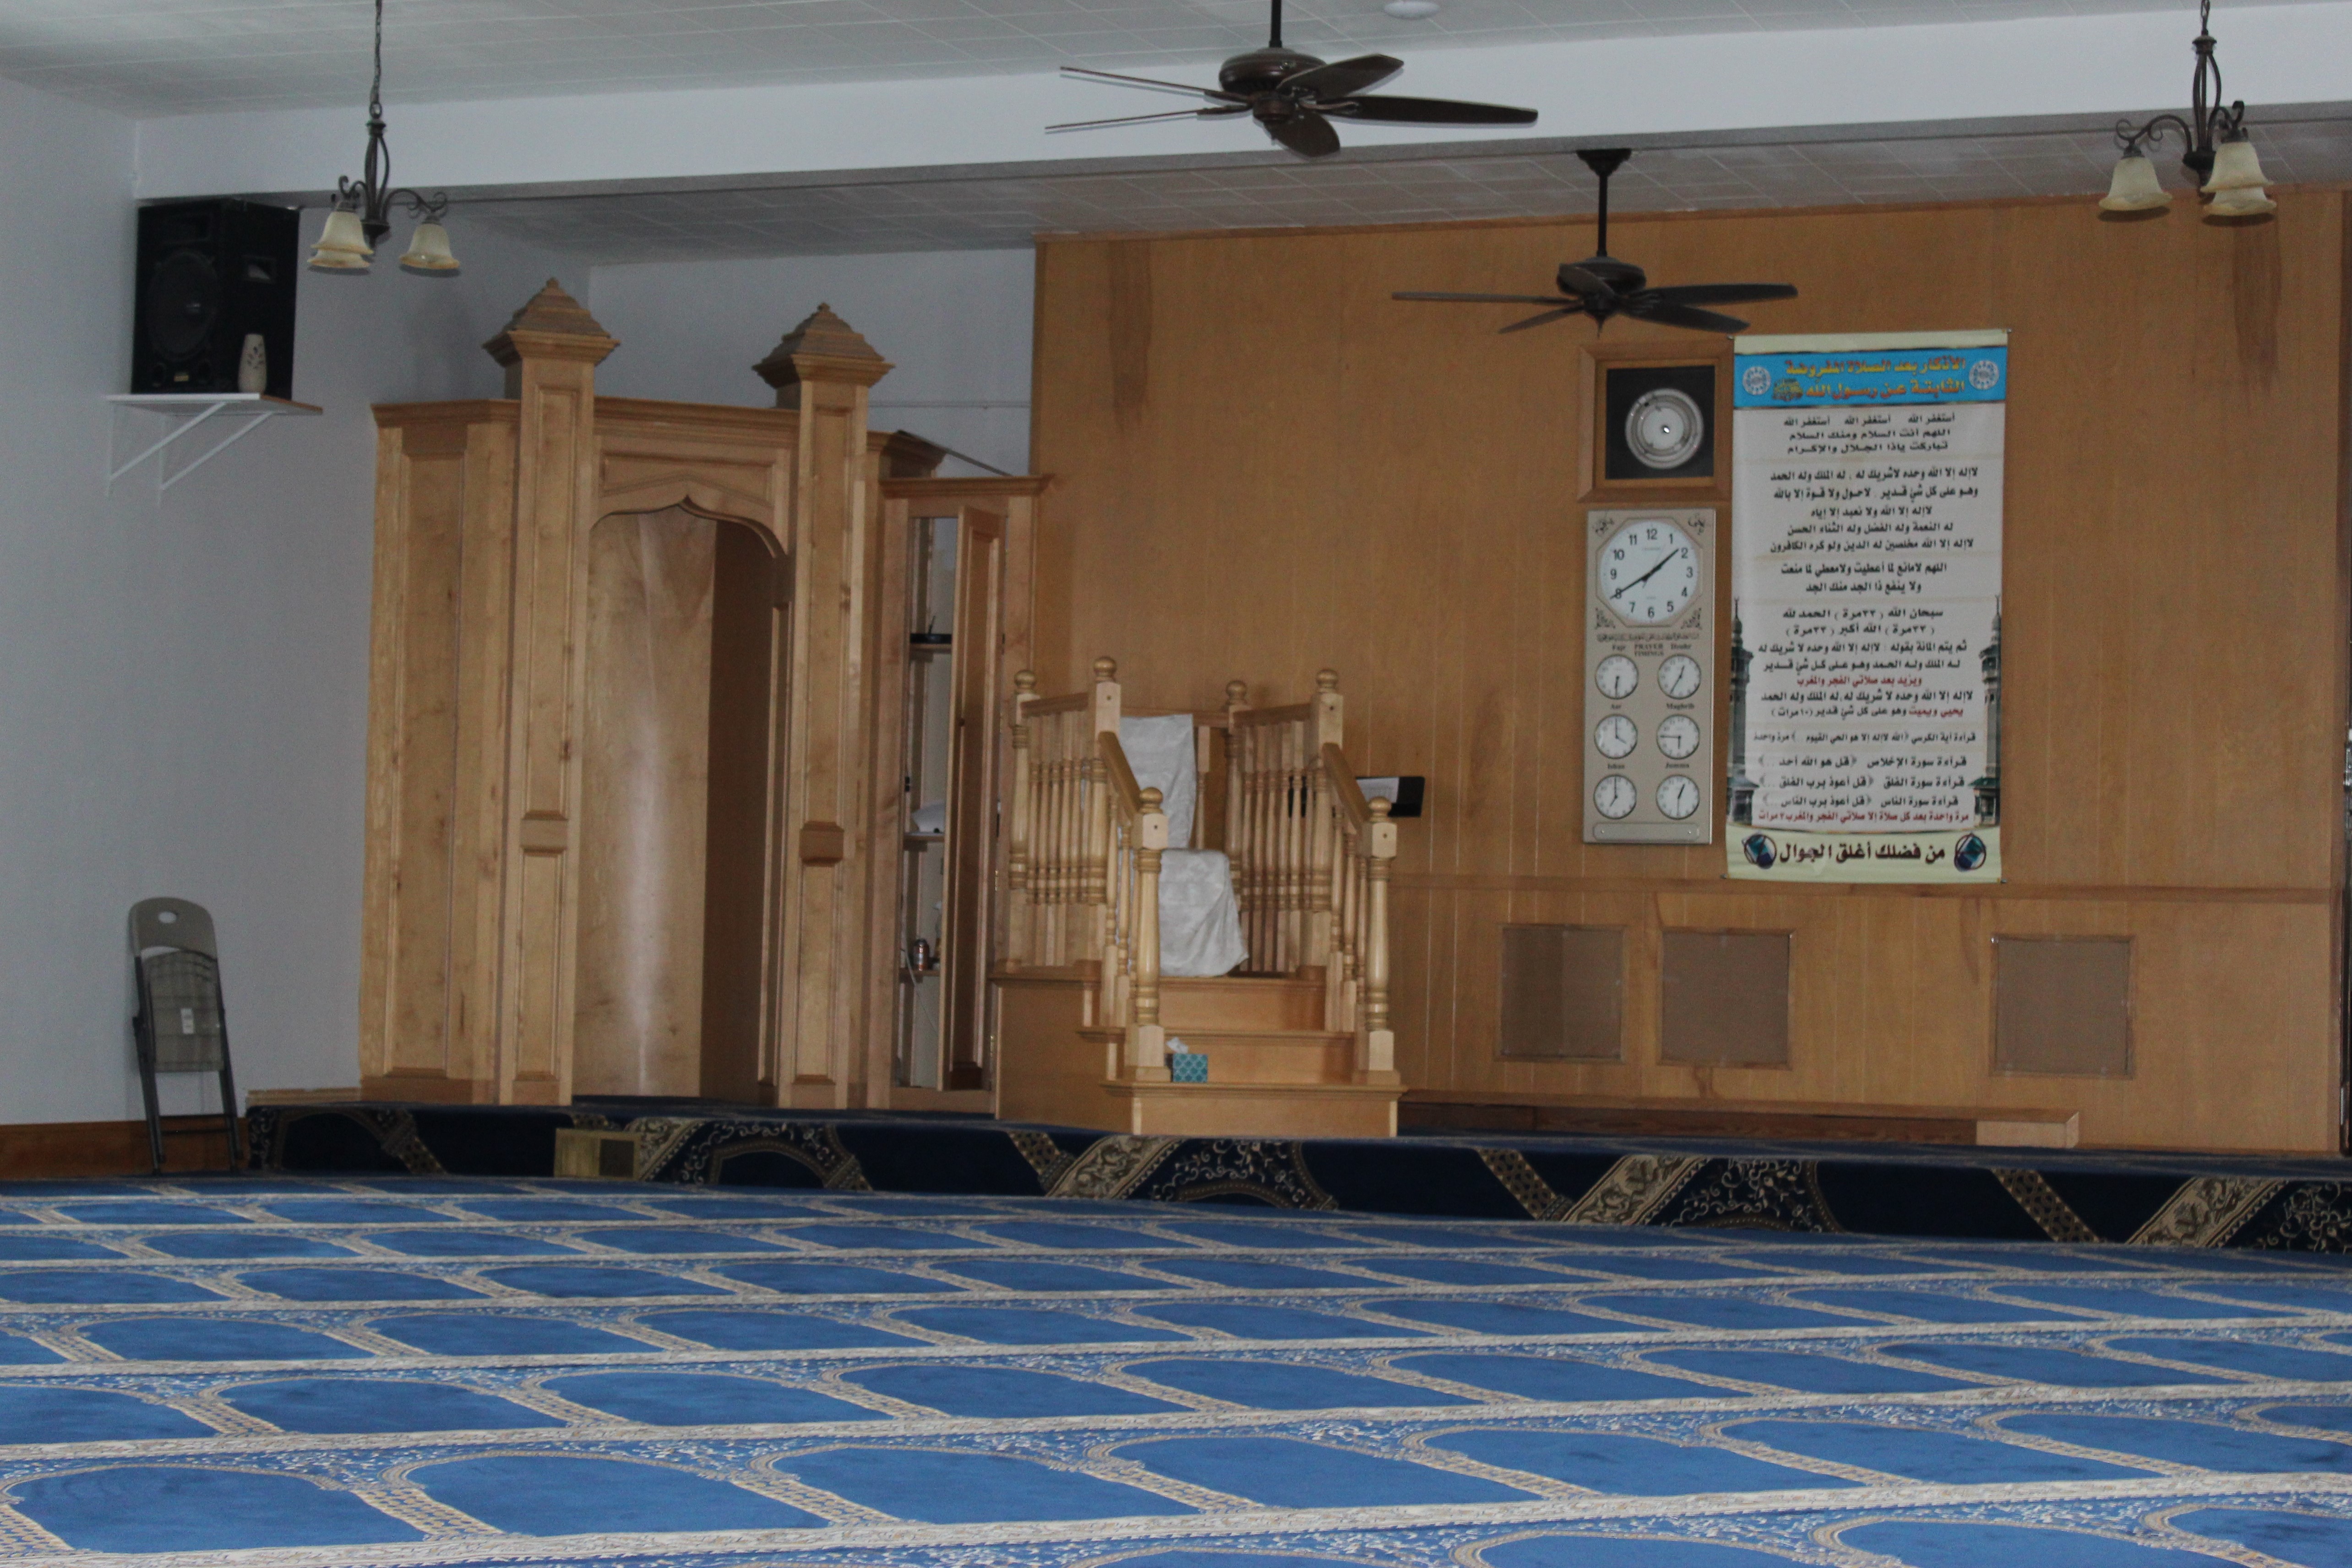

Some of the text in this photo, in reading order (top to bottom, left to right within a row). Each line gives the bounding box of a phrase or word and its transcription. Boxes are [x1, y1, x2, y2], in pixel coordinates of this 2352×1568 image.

[1846, 359, 1891, 374] الصلاة
[1895, 361, 1917, 375] بعد
[1806, 384, 1831, 397] الله
[1833, 383, 1877, 399] رسول
[1880, 382, 1906, 398] عن
[1911, 377, 1965, 398] الثابتة
[1784, 412, 1955, 427] أستغفر الله أستغفر الله أستغفر الله
[1789, 432, 1824, 441] السلام
[1828, 430, 1857, 440] ومنك
[1861, 430, 1895, 439] السلام
[1923, 428, 1950, 438] اللهم
[1841, 443, 1882, 453] الجلال
[1910, 440, 1948, 451] تباركت
[1770, 471, 1795, 480] الحمد
[1799, 471, 1812, 483] وله
[1814, 469, 1834, 479] الملك
[1837, 469, 1845, 479] له
[1856, 469, 1865, 479] له
[1903, 470, 1925, 480] وحده
[1928, 466, 1942, 477] الله
[1945, 467, 1955, 480] إلا
[1774, 487, 1791, 501] بالله
[1794, 489, 1803, 501] إلا
[1807, 486, 1824, 501] قوة
[1829, 488, 1840, 500] ولا
[1880, 485, 1907, 500] قدير
[1926, 485, 1937, 498] كل
[1959, 487, 1978, 499] وهو
[1829, 507, 1840, 518] إلا
[1843, 506, 1862, 519] نعبد
[1866, 506, 1877, 518] ولا
[1881, 505, 1895, 515] الله
[1898, 506, 1908, 517] إلا
[1788, 524, 1815, 536] الحسن
[1847, 523, 1861, 535] وله
[1864, 522, 1891, 534] الفضل
[1895, 523, 1910, 535] وله
[1913, 520, 1940, 531] النعمة
[1944, 522, 1953, 531] له
[1629, 534, 1637, 545] 11
[1647, 528, 1657, 540] 12
[1669, 534, 1673, 544] 1
[1809, 540, 1824, 552] كره
[1828, 541, 1840, 552] ولو
[1844, 540, 1869, 551] الدين
[1922, 537, 1936, 548] الله
[1940, 539, 1950, 550] إلا
[1614, 550, 1624, 560] 10
[1681, 548, 1688, 559] 2
[1611, 568, 1617, 579] 9
[1686, 566, 1693, 578] 3
[1781, 564, 1802, 573] منعت
[1925, 562, 1947, 575] اللهم
[1682, 587, 1687, 597] 4
[1806, 580, 1921, 595] ولا ينفع ذا الجد منك الجد
[1615, 588, 1622, 599] 8
[1629, 602, 1635, 613] 7
[1667, 601, 1674, 612] 5
[1888, 606, 1905, 617] الله
[1648, 607, 1654, 618] 6
[1783, 607, 1796, 618] لله
[1910, 608, 1943, 620] سبحان
[1839, 622, 1881, 637] الله أكبر
[1759, 643, 1767, 652] له
[1808, 643, 1828, 654] وحده
[1832, 641, 1845, 651] الله
[1849, 643, 1857, 654] إلا
[1938, 641, 1953, 654] يتم
[1956, 639, 1966, 653] ثم
[1764, 659, 1793, 672] قدير
[1811, 659, 1825, 671] كل
[1851, 661, 1870, 671] وهو
[1873, 659, 1901, 668] الحمد
[1905, 659, 1922, 670] وله
[1925, 659, 1944, 668] الملك
[1947, 659, 1960, 668] له
[1827, 675, 1850, 687] الفجر
[1881, 677, 1895, 687] بعد
[1761, 692, 1786, 700] الحمد
[1791, 691, 1804, 703] وله
[1807, 691, 1826, 701] الملك
[1896, 692, 1918, 703] وحده
[1922, 689, 1936, 700] الله
[1939, 690, 1949, 703] إلا
[1815, 705, 1837, 717] قدير
[1857, 706, 1867, 716] كل
[1891, 708, 1906, 717] وهو
[1817, 811, 1837, 822] الفجر
[1879, 810, 1897, 821] صلاة
[1900, 811, 1910, 822] كل
[1913, 813, 1926, 823] بعد
[1780, 841, 1945, 864] من فضلك أغلق الجوال
